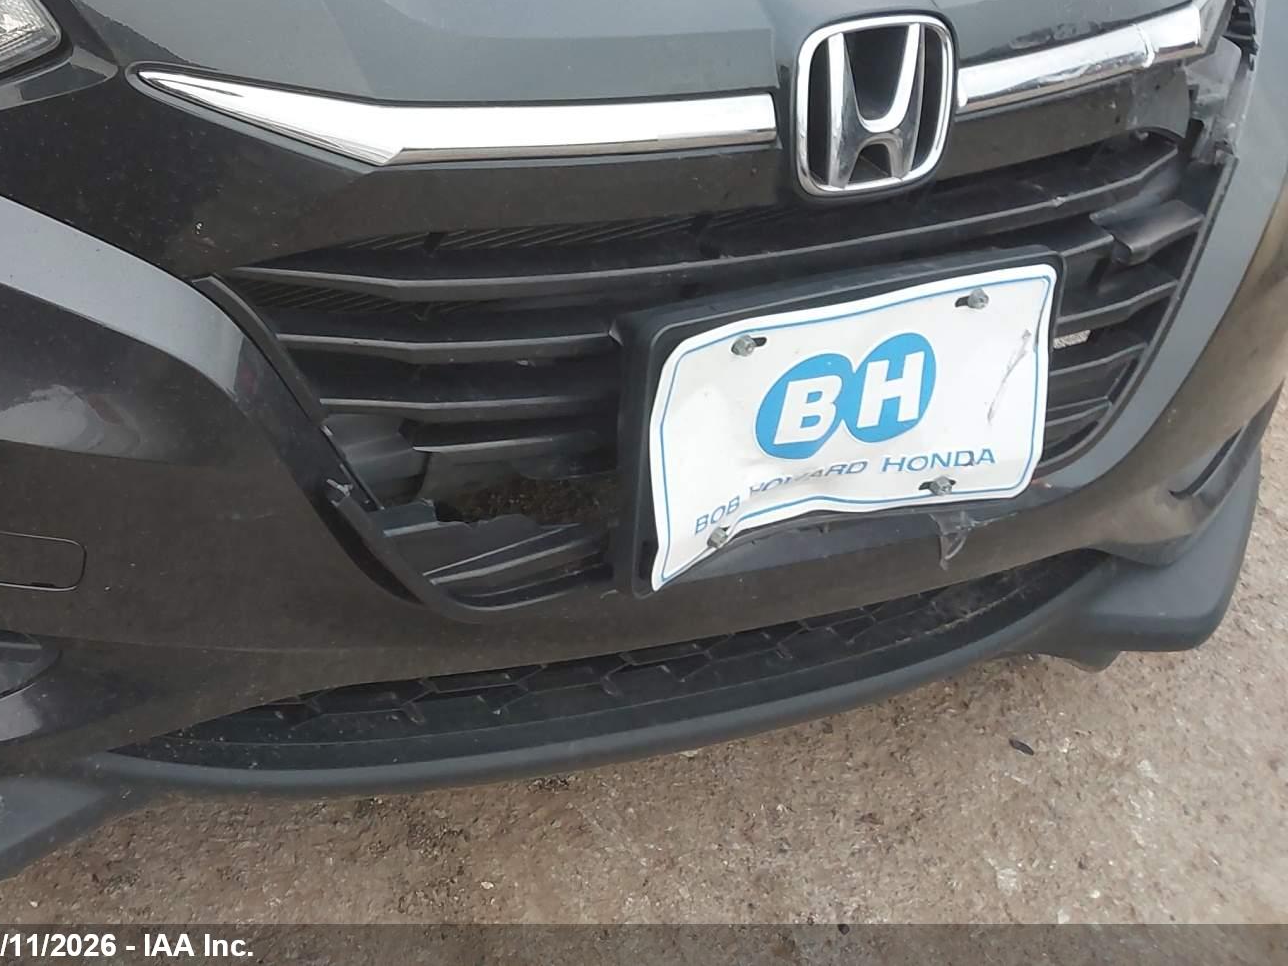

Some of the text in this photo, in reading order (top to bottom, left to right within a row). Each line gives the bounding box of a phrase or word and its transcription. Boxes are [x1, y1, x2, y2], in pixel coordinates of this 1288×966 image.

[773, 351, 925, 445] BH
[695, 495, 741, 534] BOB
[881, 448, 996, 472] HONDA
